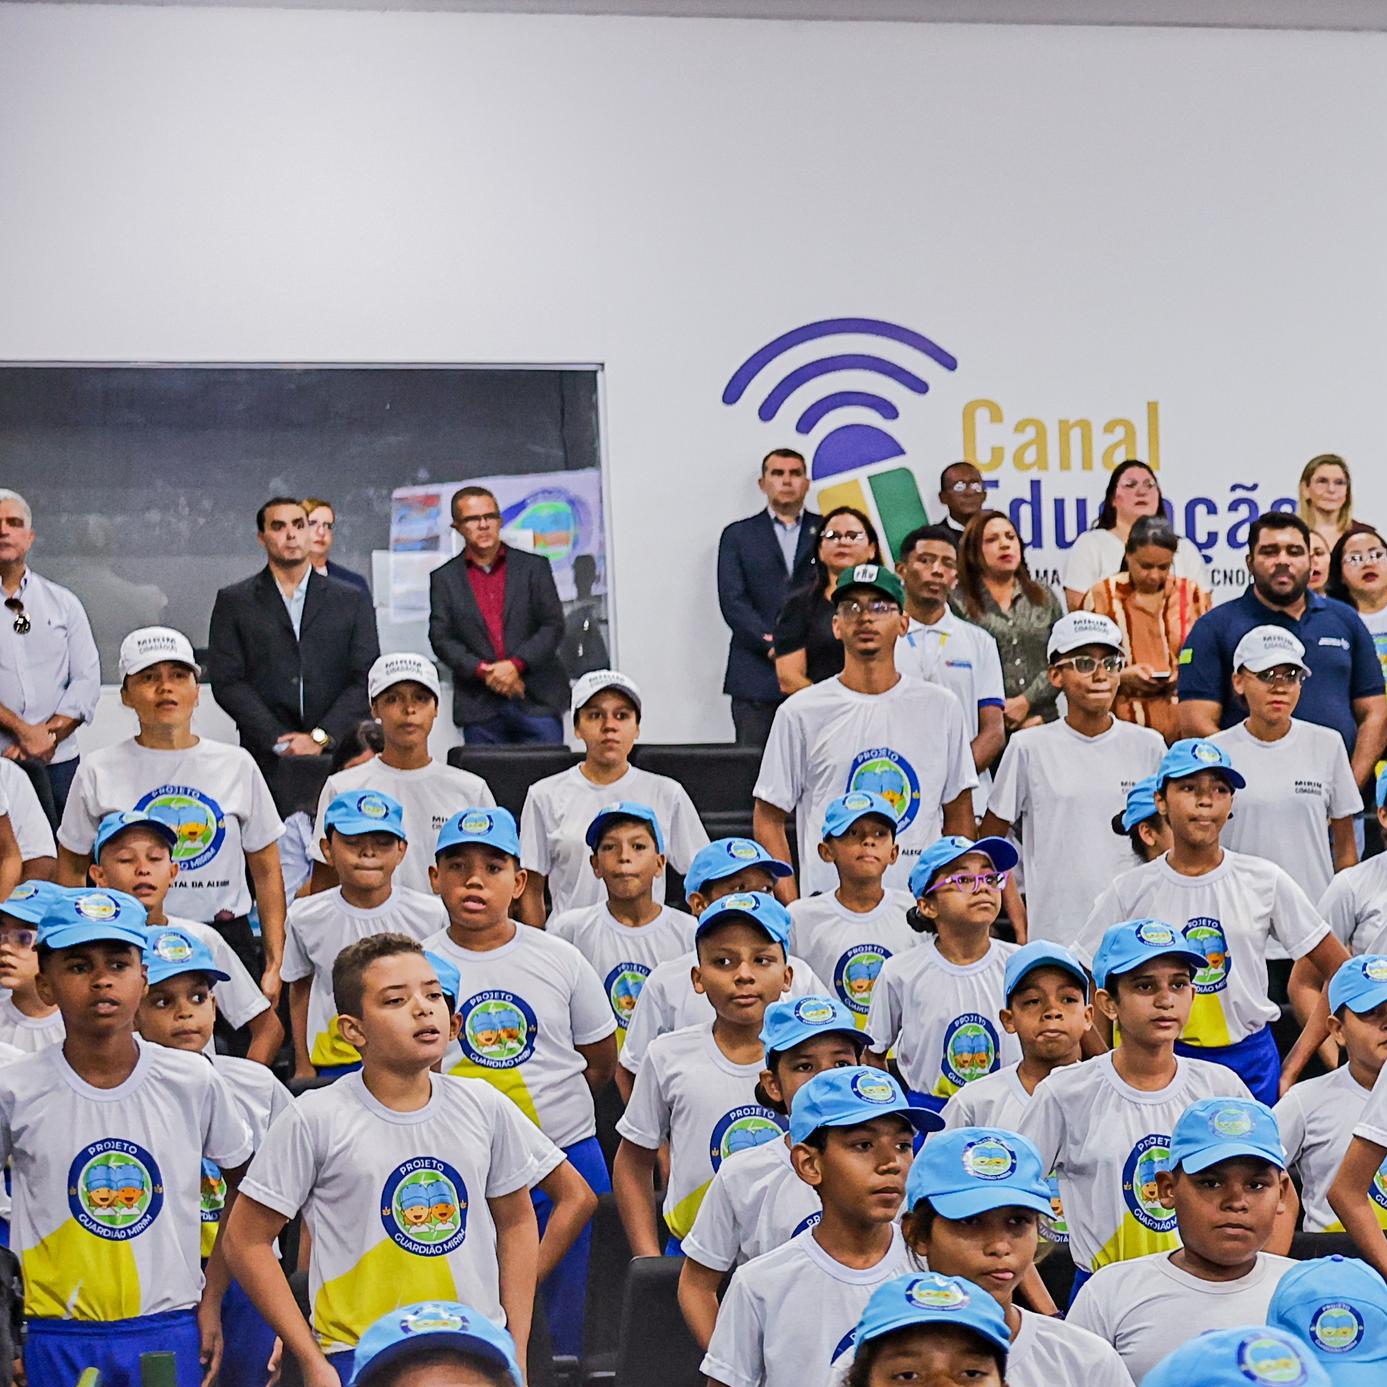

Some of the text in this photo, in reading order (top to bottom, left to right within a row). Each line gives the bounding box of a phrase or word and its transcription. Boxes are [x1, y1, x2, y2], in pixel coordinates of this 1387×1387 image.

[962, 399, 1161, 472] Canal
[1188, 918, 1218, 929] ROJETO
[470, 992, 513, 1007] PROJETO
[469, 1053, 512, 1068] GUARDIÃO
[729, 1106, 775, 1121] PROJETO
[88, 1143, 137, 1156] PROJETO
[399, 1159, 444, 1175] PROJETO
[78, 1213, 153, 1239] GUARDIÃO MIRIM
[394, 1230, 465, 1255] GUARDIÃO MIRIM
